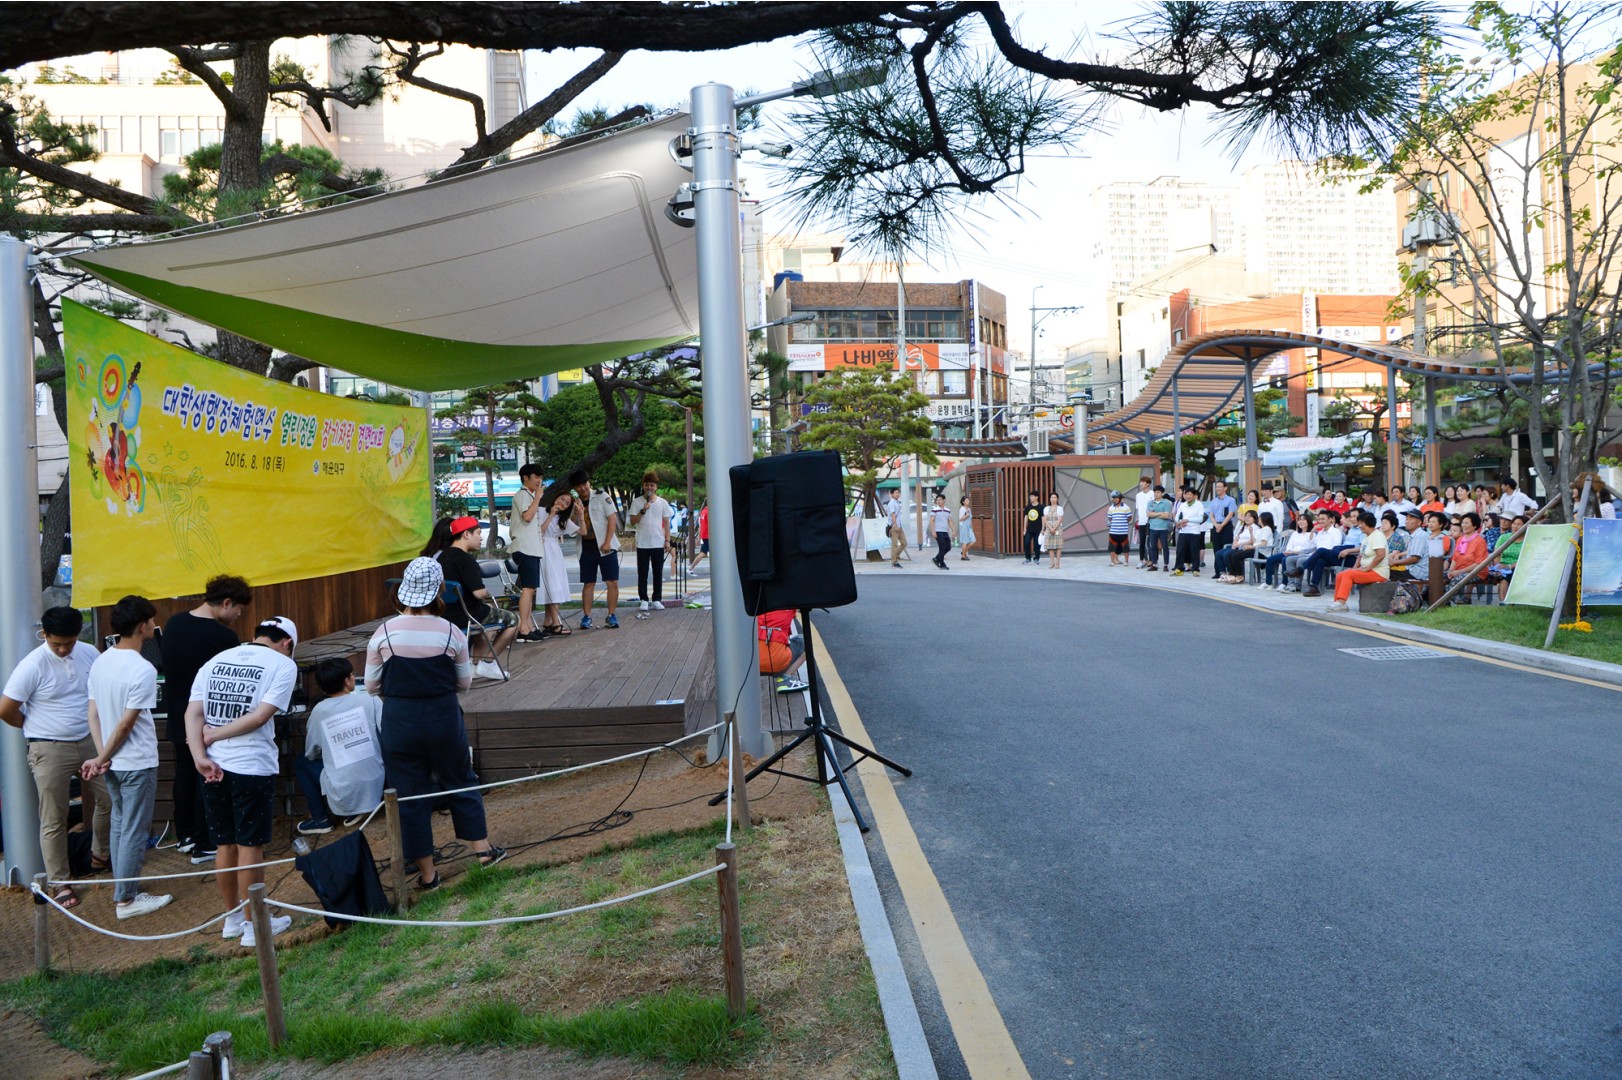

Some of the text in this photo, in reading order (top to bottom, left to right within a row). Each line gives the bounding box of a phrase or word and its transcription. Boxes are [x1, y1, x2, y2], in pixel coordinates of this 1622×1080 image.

[162, 385, 277, 442] 대학생행정체험연수
[281, 411, 318, 447] 열린정원
[322, 420, 354, 450] 장기자랑
[225, 451, 285, 472] 2016. 8. 18(목)
[212, 665, 263, 680] CHANGING
[209, 680, 246, 694] WORLD
[227, 695, 247, 703] BETTER
[330, 726, 366, 744] TRAVEL
